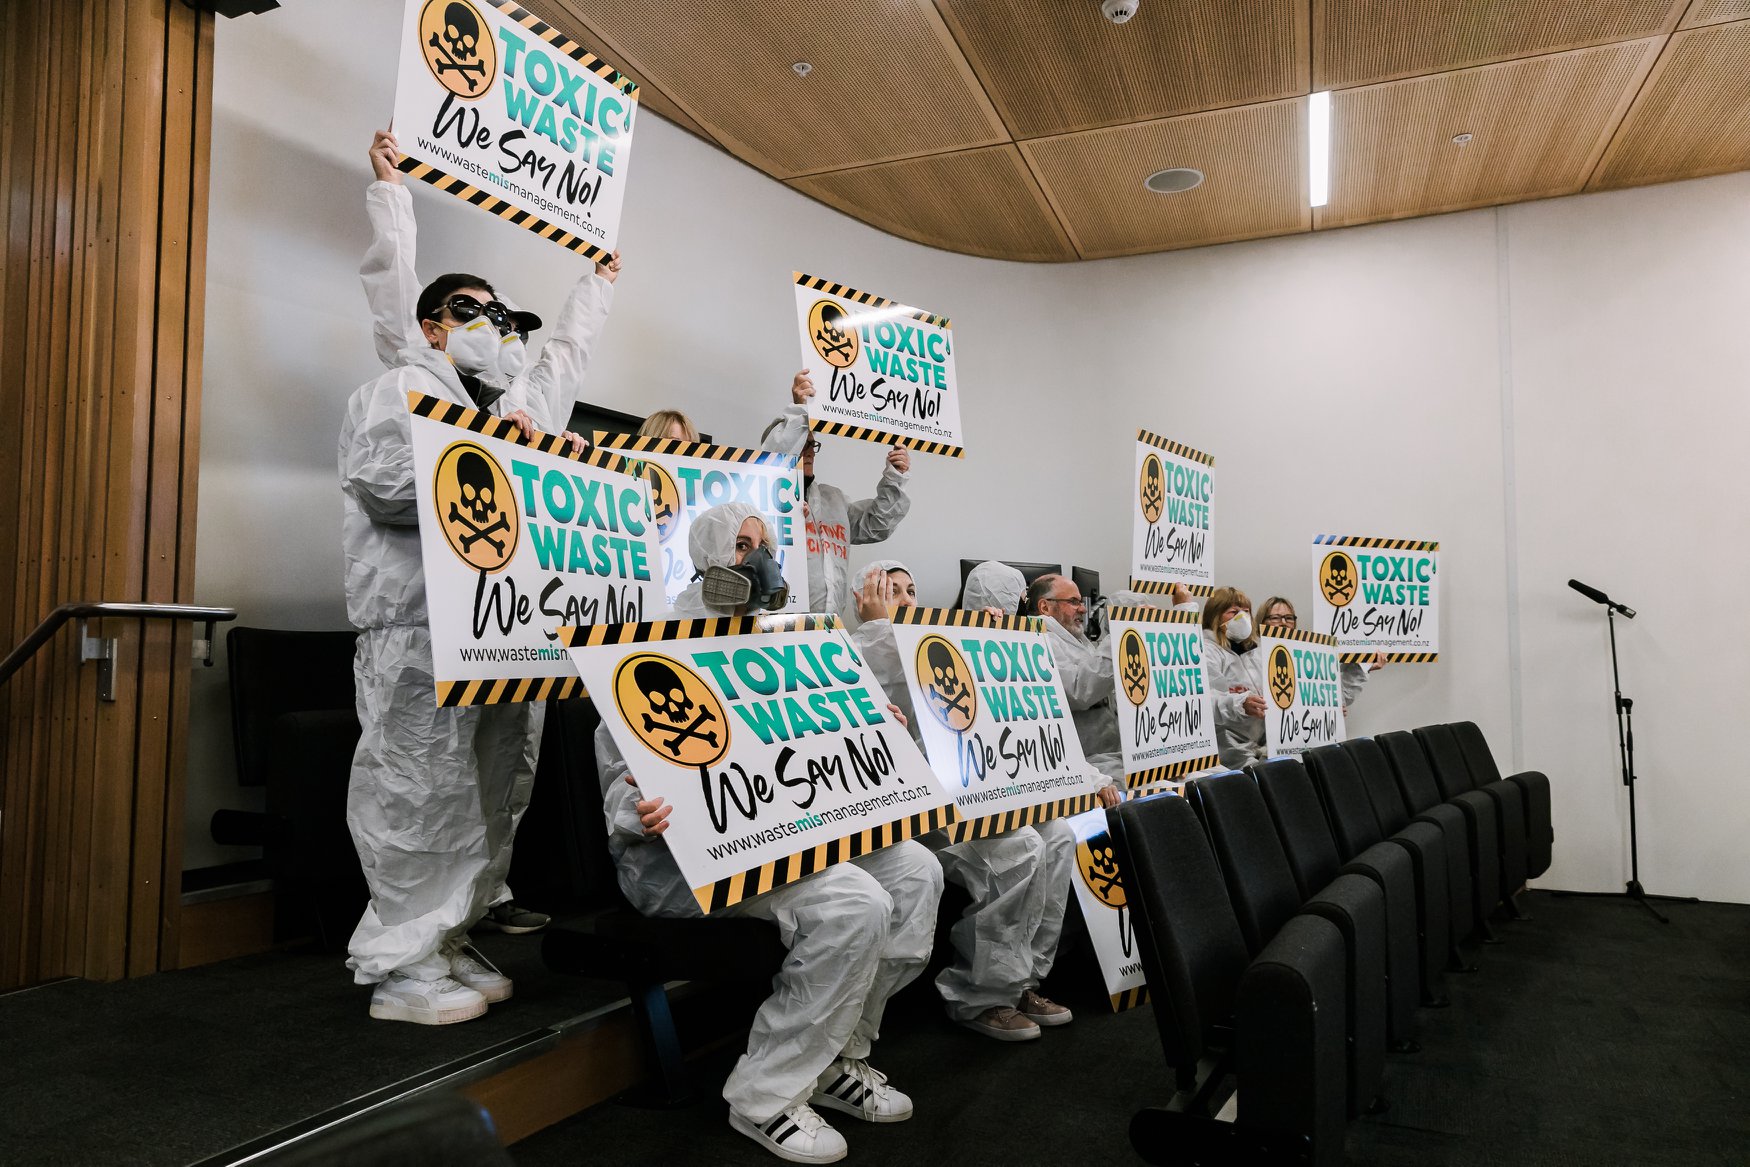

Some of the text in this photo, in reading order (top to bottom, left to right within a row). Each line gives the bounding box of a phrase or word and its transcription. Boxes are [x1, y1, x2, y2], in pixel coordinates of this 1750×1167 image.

[499, 26, 623, 139] TOXIC
[504, 79, 616, 177] WASTE
[432, 92, 494, 148] We
[556, 160, 602, 218] No!
[417, 137, 606, 239] www.wastemismanagement.co.nz
[859, 317, 946, 363] TOXIC
[864, 346, 947, 390] WASTE
[830, 367, 866, 403] We
[912, 388, 941, 425] No!
[822, 404, 952, 438] www.wastemismanagement.co.nz
[511, 459, 646, 537] TOXIC
[678, 467, 793, 513] TOXIC
[1165, 461, 1210, 502] TOXIC
[1167, 496, 1209, 530] WASTE
[527, 522, 651, 582] WASTE
[1144, 523, 1164, 560] We
[1188, 532, 1204, 567] No!
[1357, 554, 1430, 583] TOXIC
[472, 570, 534, 640] We
[1362, 583, 1430, 606] WASTE
[1331, 606, 1360, 636] We
[1397, 608, 1422, 638] No!
[691, 641, 860, 701] TOXIC
[961, 640, 1052, 682] TOXIC
[1145, 632, 1200, 666] TOXIC
[1294, 649, 1336, 682] TOXIC
[980, 685, 1064, 722] WASTE
[1152, 668, 1204, 698] WASTE
[1298, 682, 1338, 707] WASTE
[732, 688, 886, 746] WASTE
[1135, 705, 1156, 748] We
[1184, 698, 1202, 736] No!
[1280, 709, 1299, 744] We
[956, 729, 997, 788] We
[1038, 723, 1070, 772] No!
[700, 761, 774, 834] We
[844, 730, 905, 791] No!
[956, 774, 1084, 807] www.wastemismanagement.co.nz
[706, 784, 932, 861] www.wastemismanagement.co.nz
